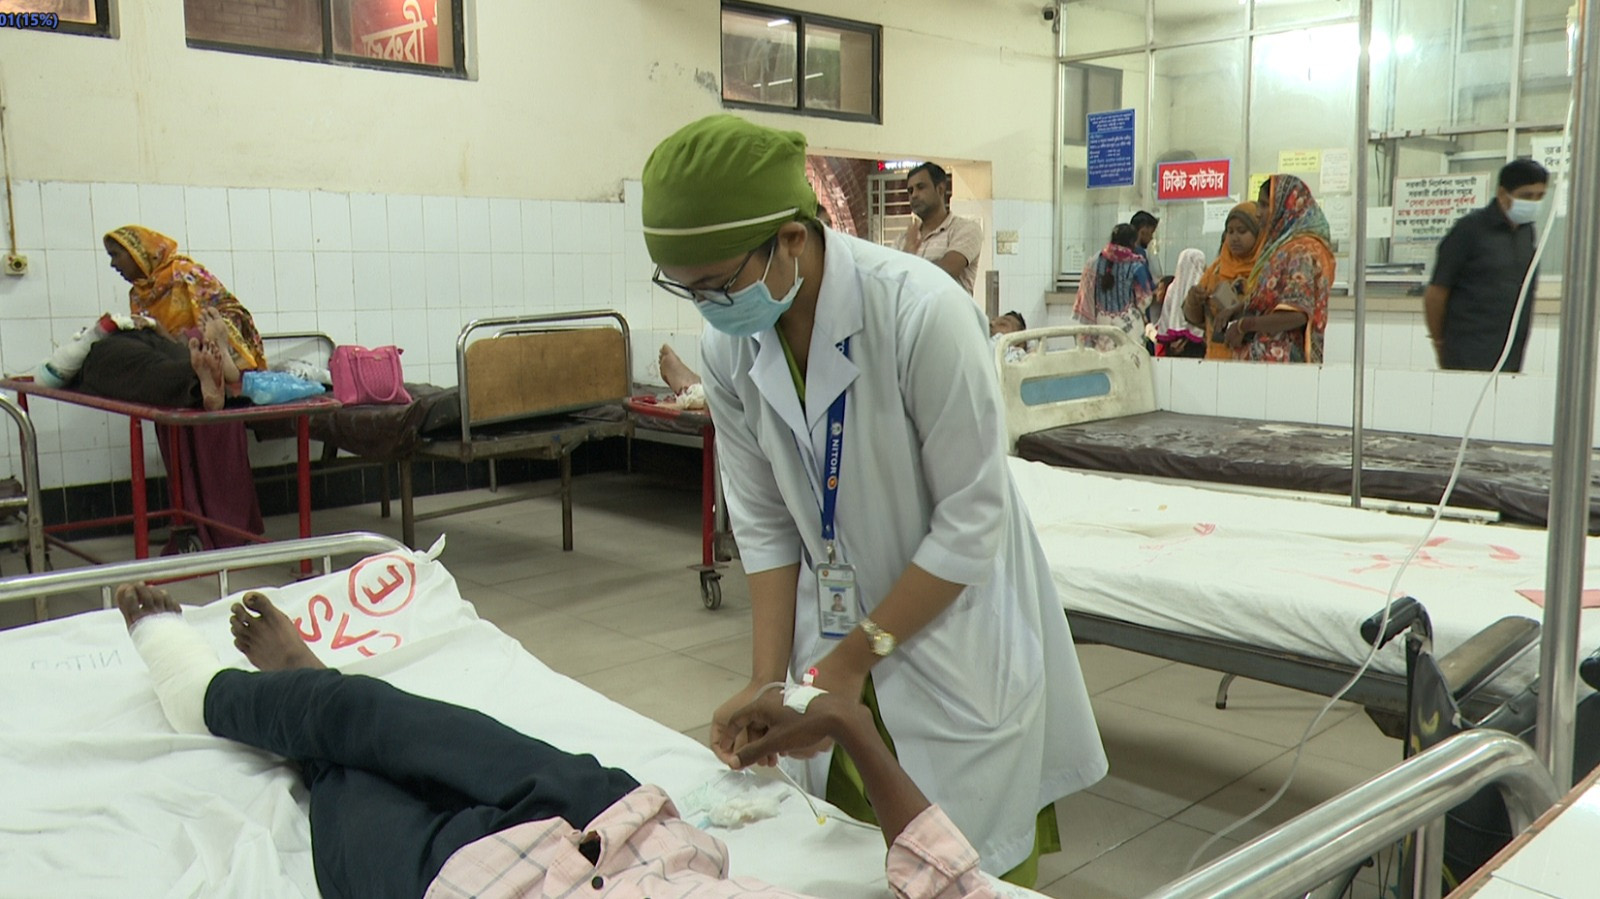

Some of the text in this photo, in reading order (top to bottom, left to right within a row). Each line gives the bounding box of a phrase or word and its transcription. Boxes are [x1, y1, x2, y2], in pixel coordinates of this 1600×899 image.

[1162, 169, 1187, 193] টিকিট
[1188, 167, 1225, 192] কাউন্টার
[829, 438, 840, 475] NITOR
